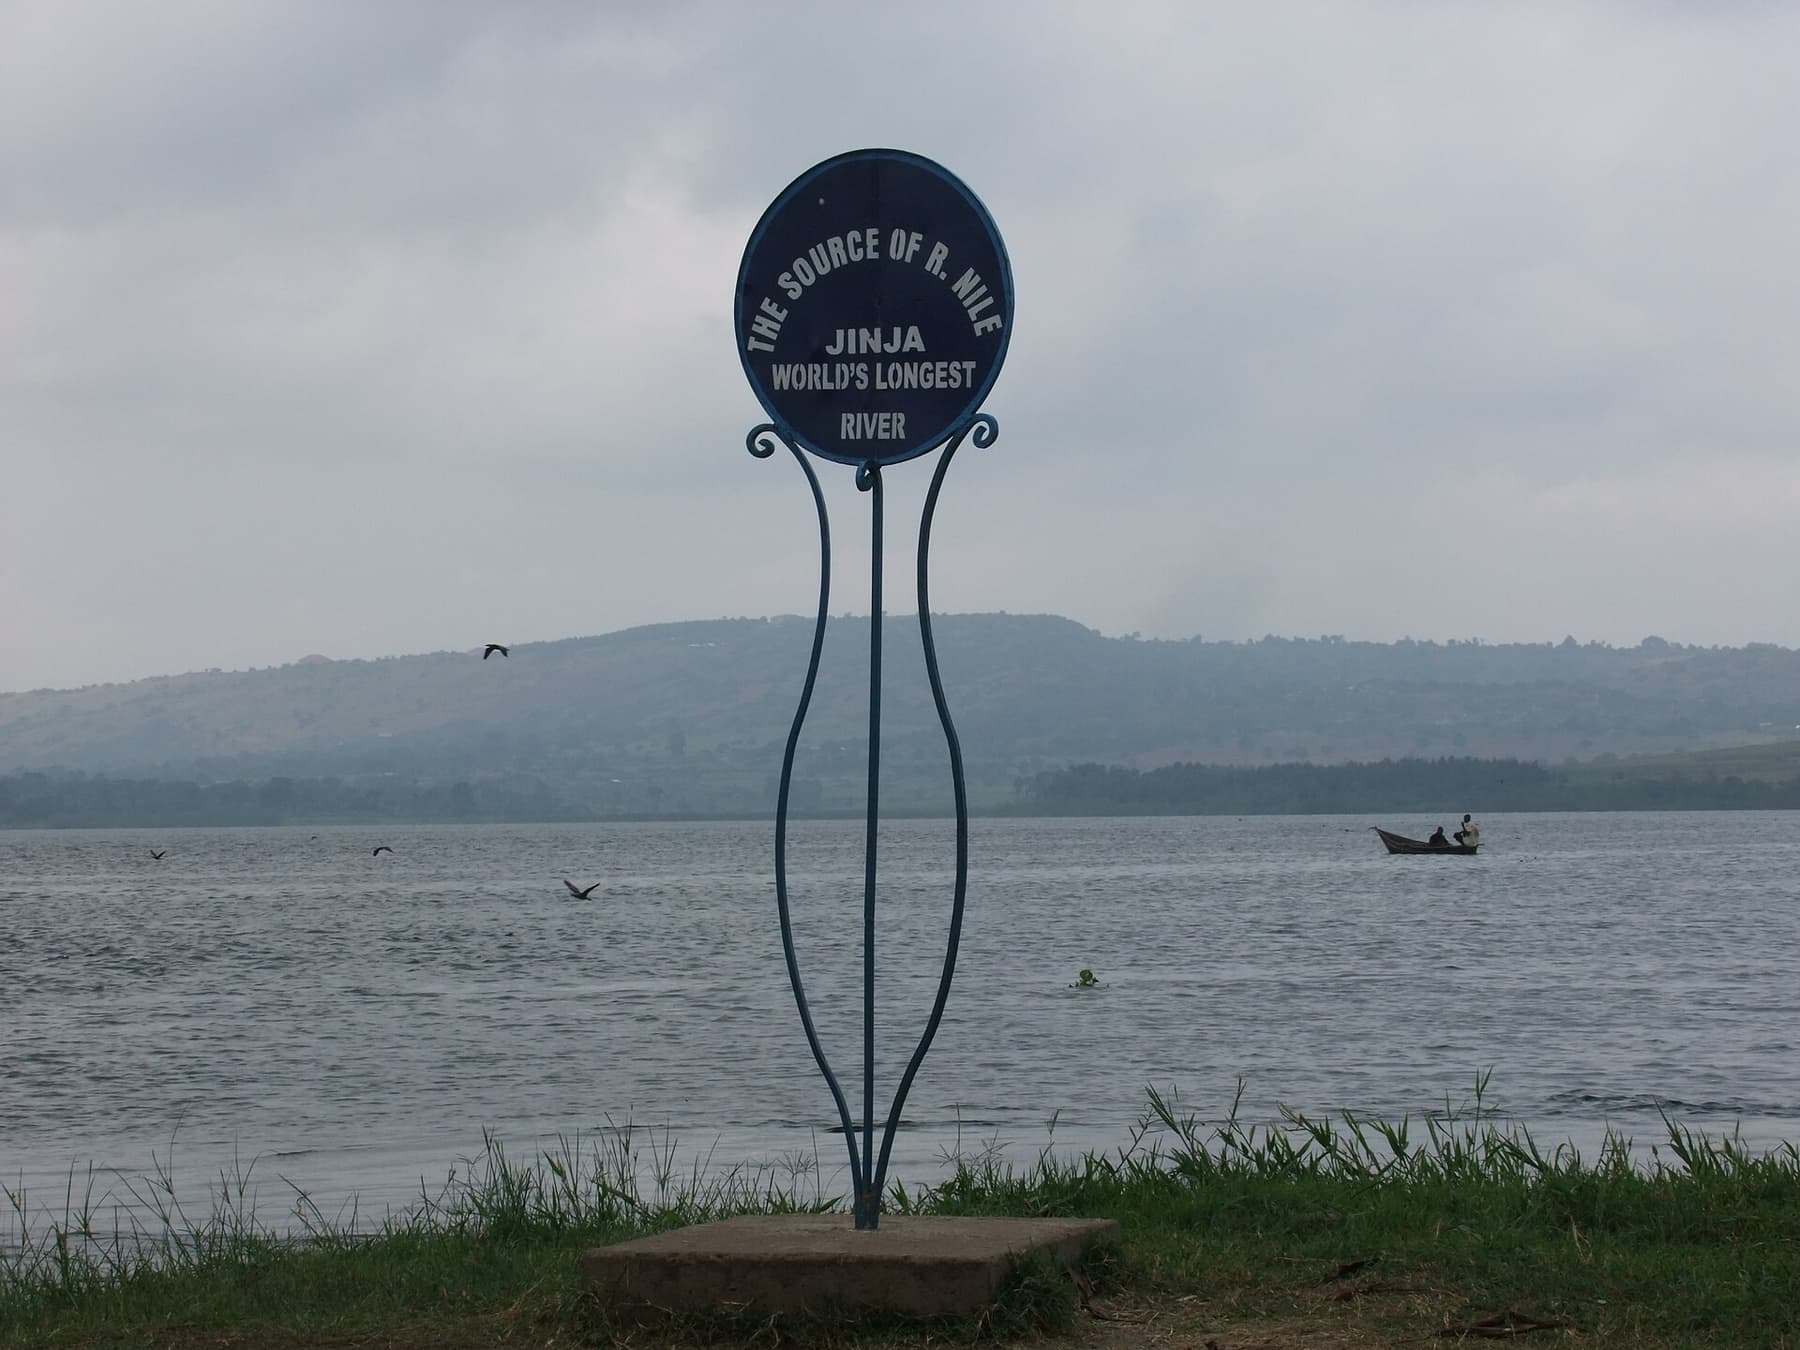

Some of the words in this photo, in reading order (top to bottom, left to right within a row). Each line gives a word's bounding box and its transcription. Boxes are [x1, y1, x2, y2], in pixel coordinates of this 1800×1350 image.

[748, 297, 788, 352] THE
[778, 228, 879, 299] SOURCE
[889, 228, 923, 263] OF
[925, 241, 949, 281] R.
[951, 267, 1003, 337] NILE
[825, 326, 926, 355] JINJA
[772, 363, 869, 390] WORLD'S
[875, 361, 977, 390] LONGEST
[840, 412, 906, 439] RIVER
